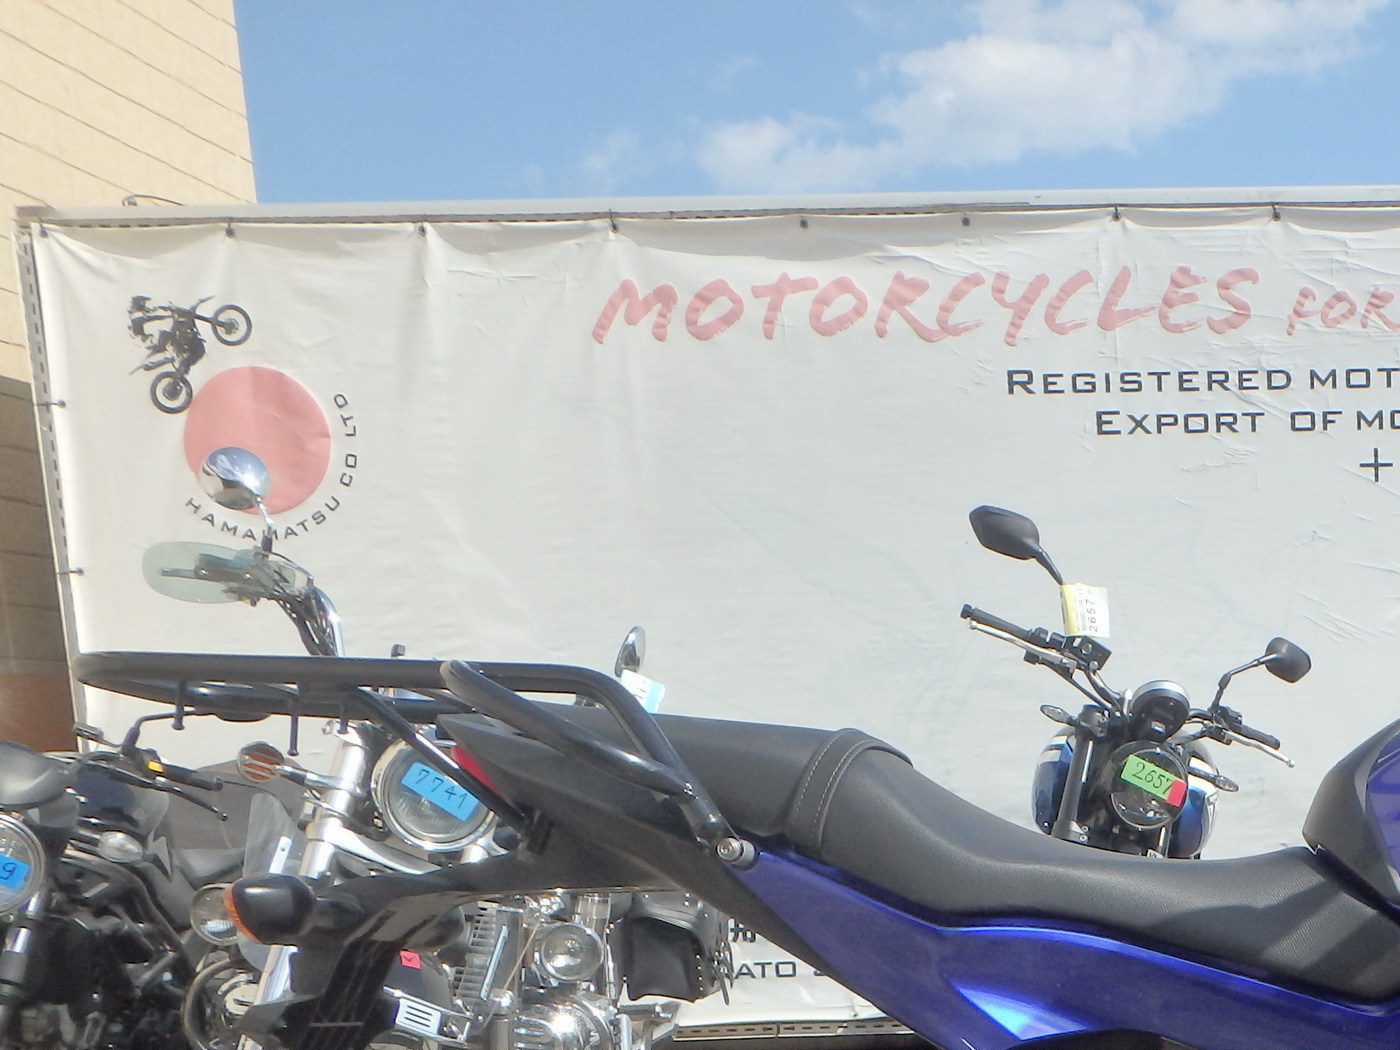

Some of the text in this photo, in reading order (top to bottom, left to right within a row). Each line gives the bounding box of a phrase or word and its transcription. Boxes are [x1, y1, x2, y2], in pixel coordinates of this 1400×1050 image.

[592, 265, 1260, 347] MOTORCYCLES
[333, 393, 357, 437] LTD
[1290, 411, 1344, 433] OF
[339, 453, 358, 487] CO
[415, 768, 468, 810] 7741
[1131, 761, 1175, 795] 2657
